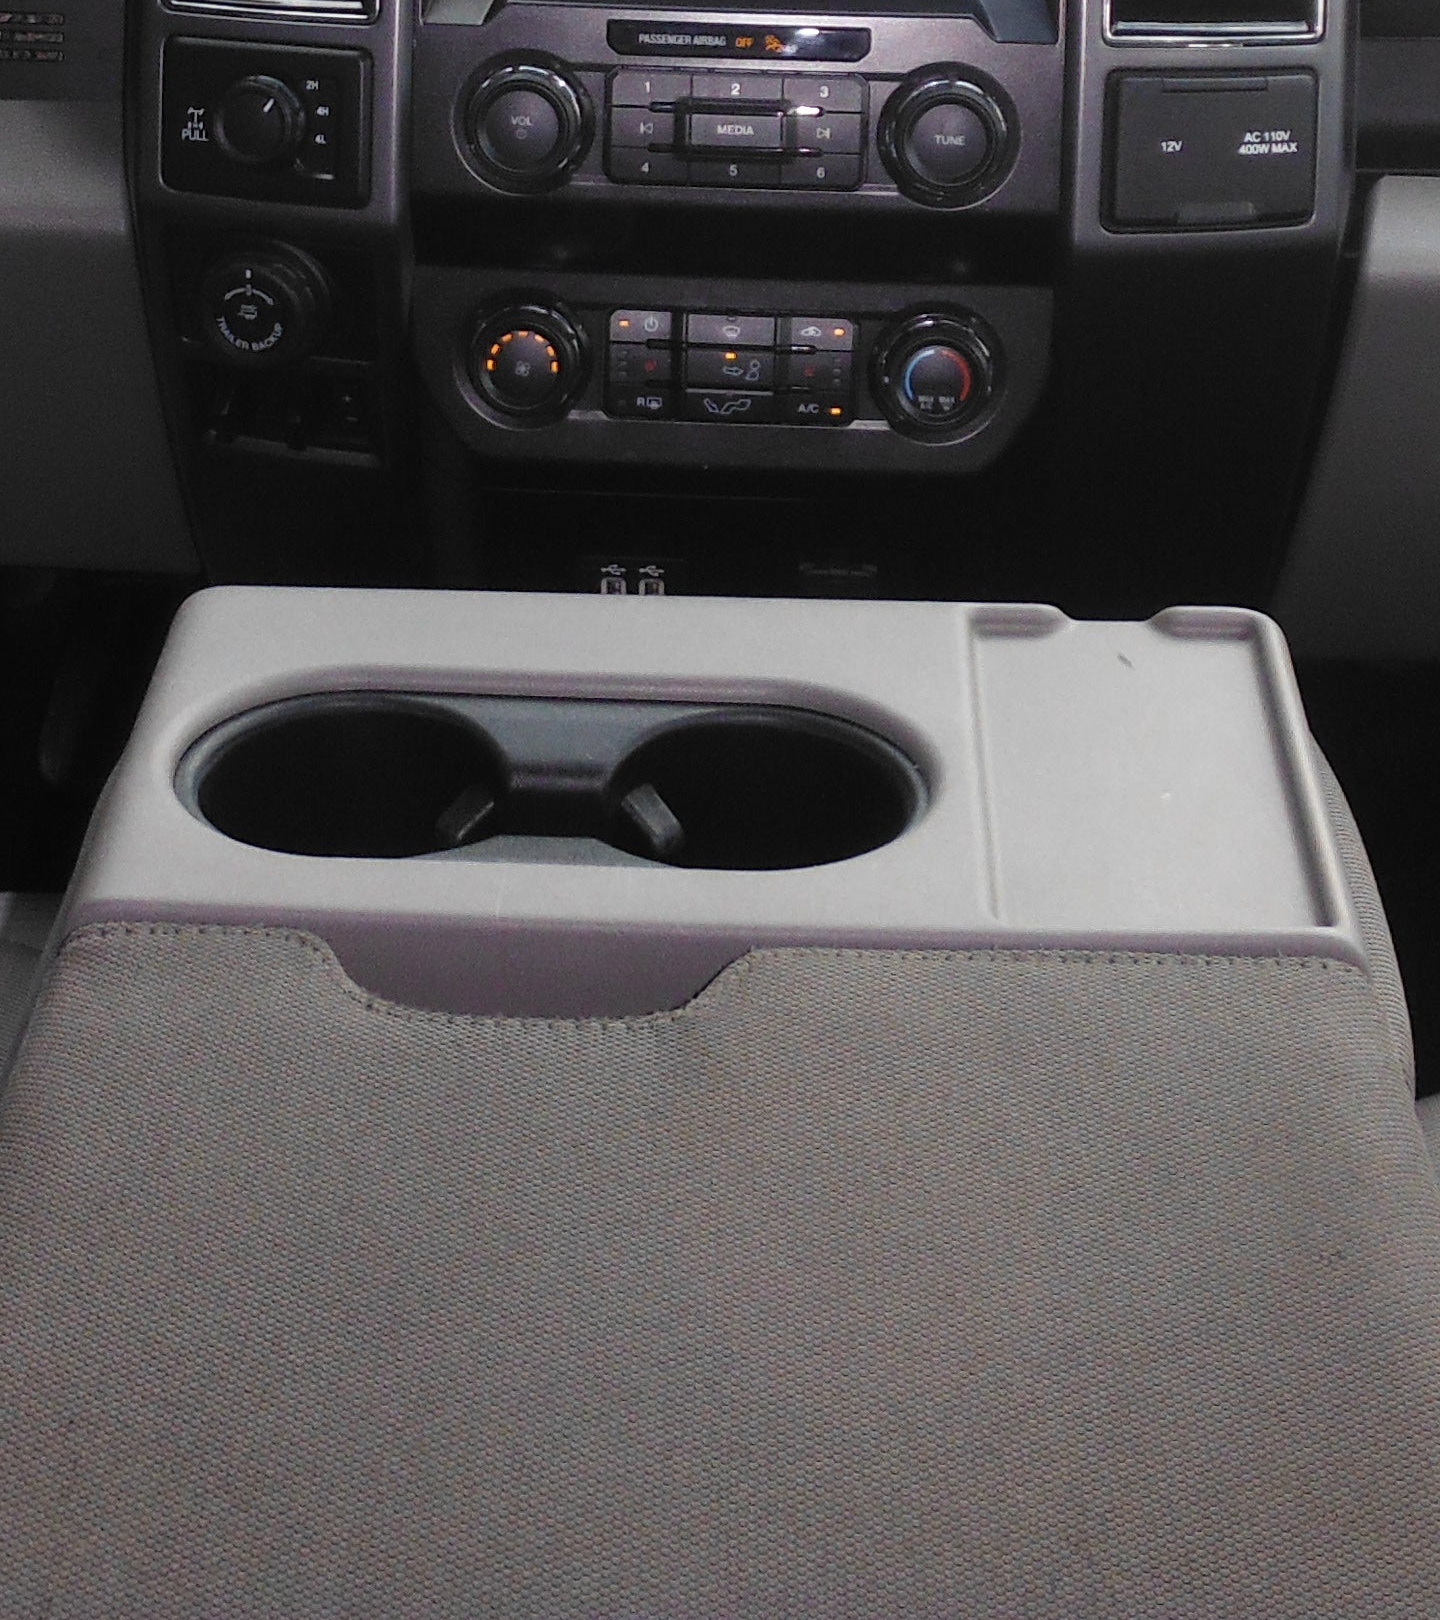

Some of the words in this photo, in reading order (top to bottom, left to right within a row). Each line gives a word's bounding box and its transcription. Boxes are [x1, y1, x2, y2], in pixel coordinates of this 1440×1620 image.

[638, 33, 692, 45] PASSENGER
[693, 35, 727, 46] AIRBAG
[735, 37, 754, 48] OFF
[305, 80, 319, 90] 2H
[644, 81, 651, 93] 1
[731, 83, 740, 95] 2
[820, 85, 829, 98] 3
[316, 106, 329, 116] 4H
[511, 115, 532, 126] VOL
[181, 128, 209, 141] PULL
[717, 125, 754, 136] MEDIA
[1244, 131, 1261, 142] AC
[1263, 130, 1291, 141] 110V
[934, 134, 966, 146] TUNE
[1161, 140, 1182, 152] 12V
[1239, 143, 1270, 155] 400W
[1271, 142, 1298, 153] MAX
[641, 162, 650, 173] 4
[729, 164, 738, 176] 5
[816, 167, 825, 178] 6
[216, 316, 250, 350] TRAILER
[251, 322, 284, 351] BACKUP
[798, 403, 819, 413] A/C
